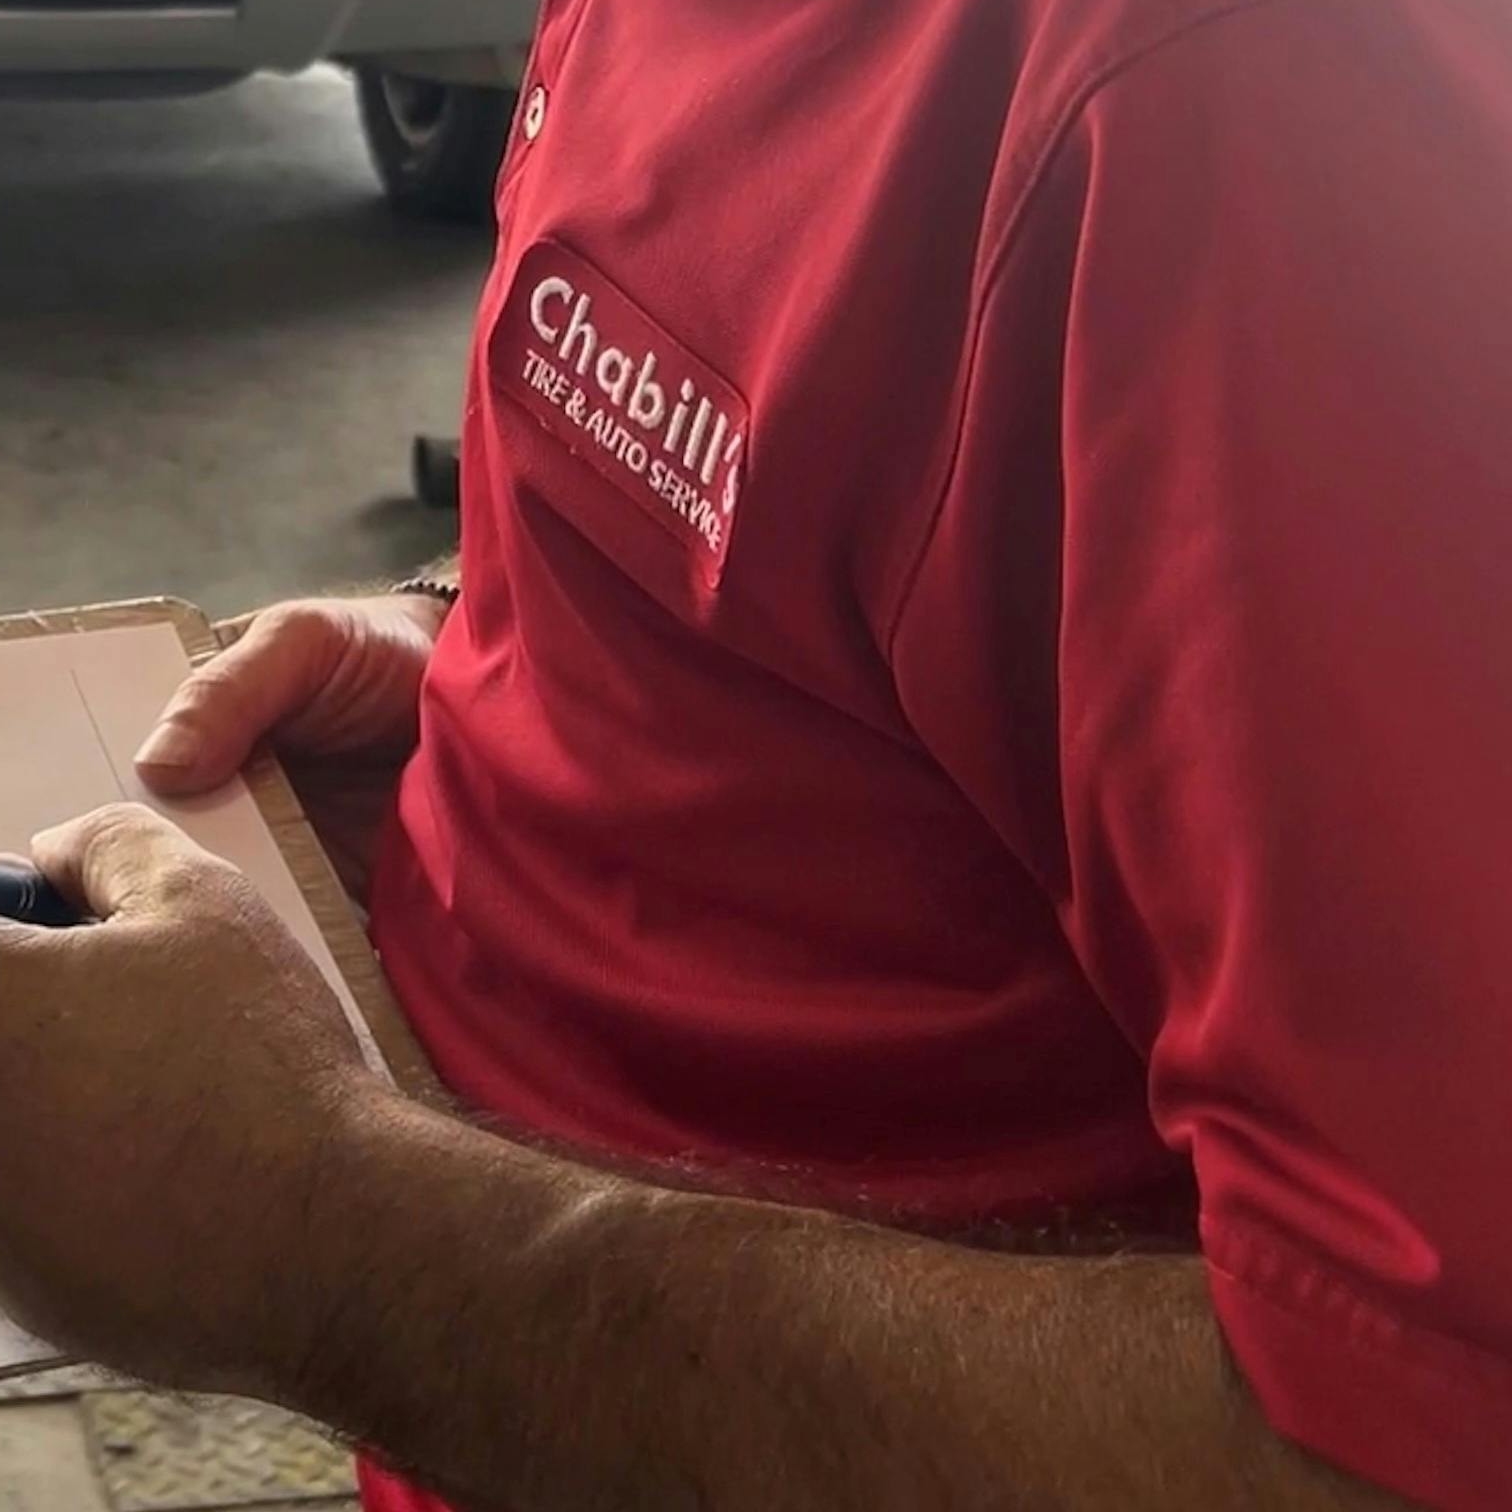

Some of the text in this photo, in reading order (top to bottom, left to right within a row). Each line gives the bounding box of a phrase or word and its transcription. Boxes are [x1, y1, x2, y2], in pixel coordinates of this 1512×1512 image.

[522, 348, 570, 403] TIRE
[565, 388, 588, 424] &
[585, 409, 648, 473] AUTO
